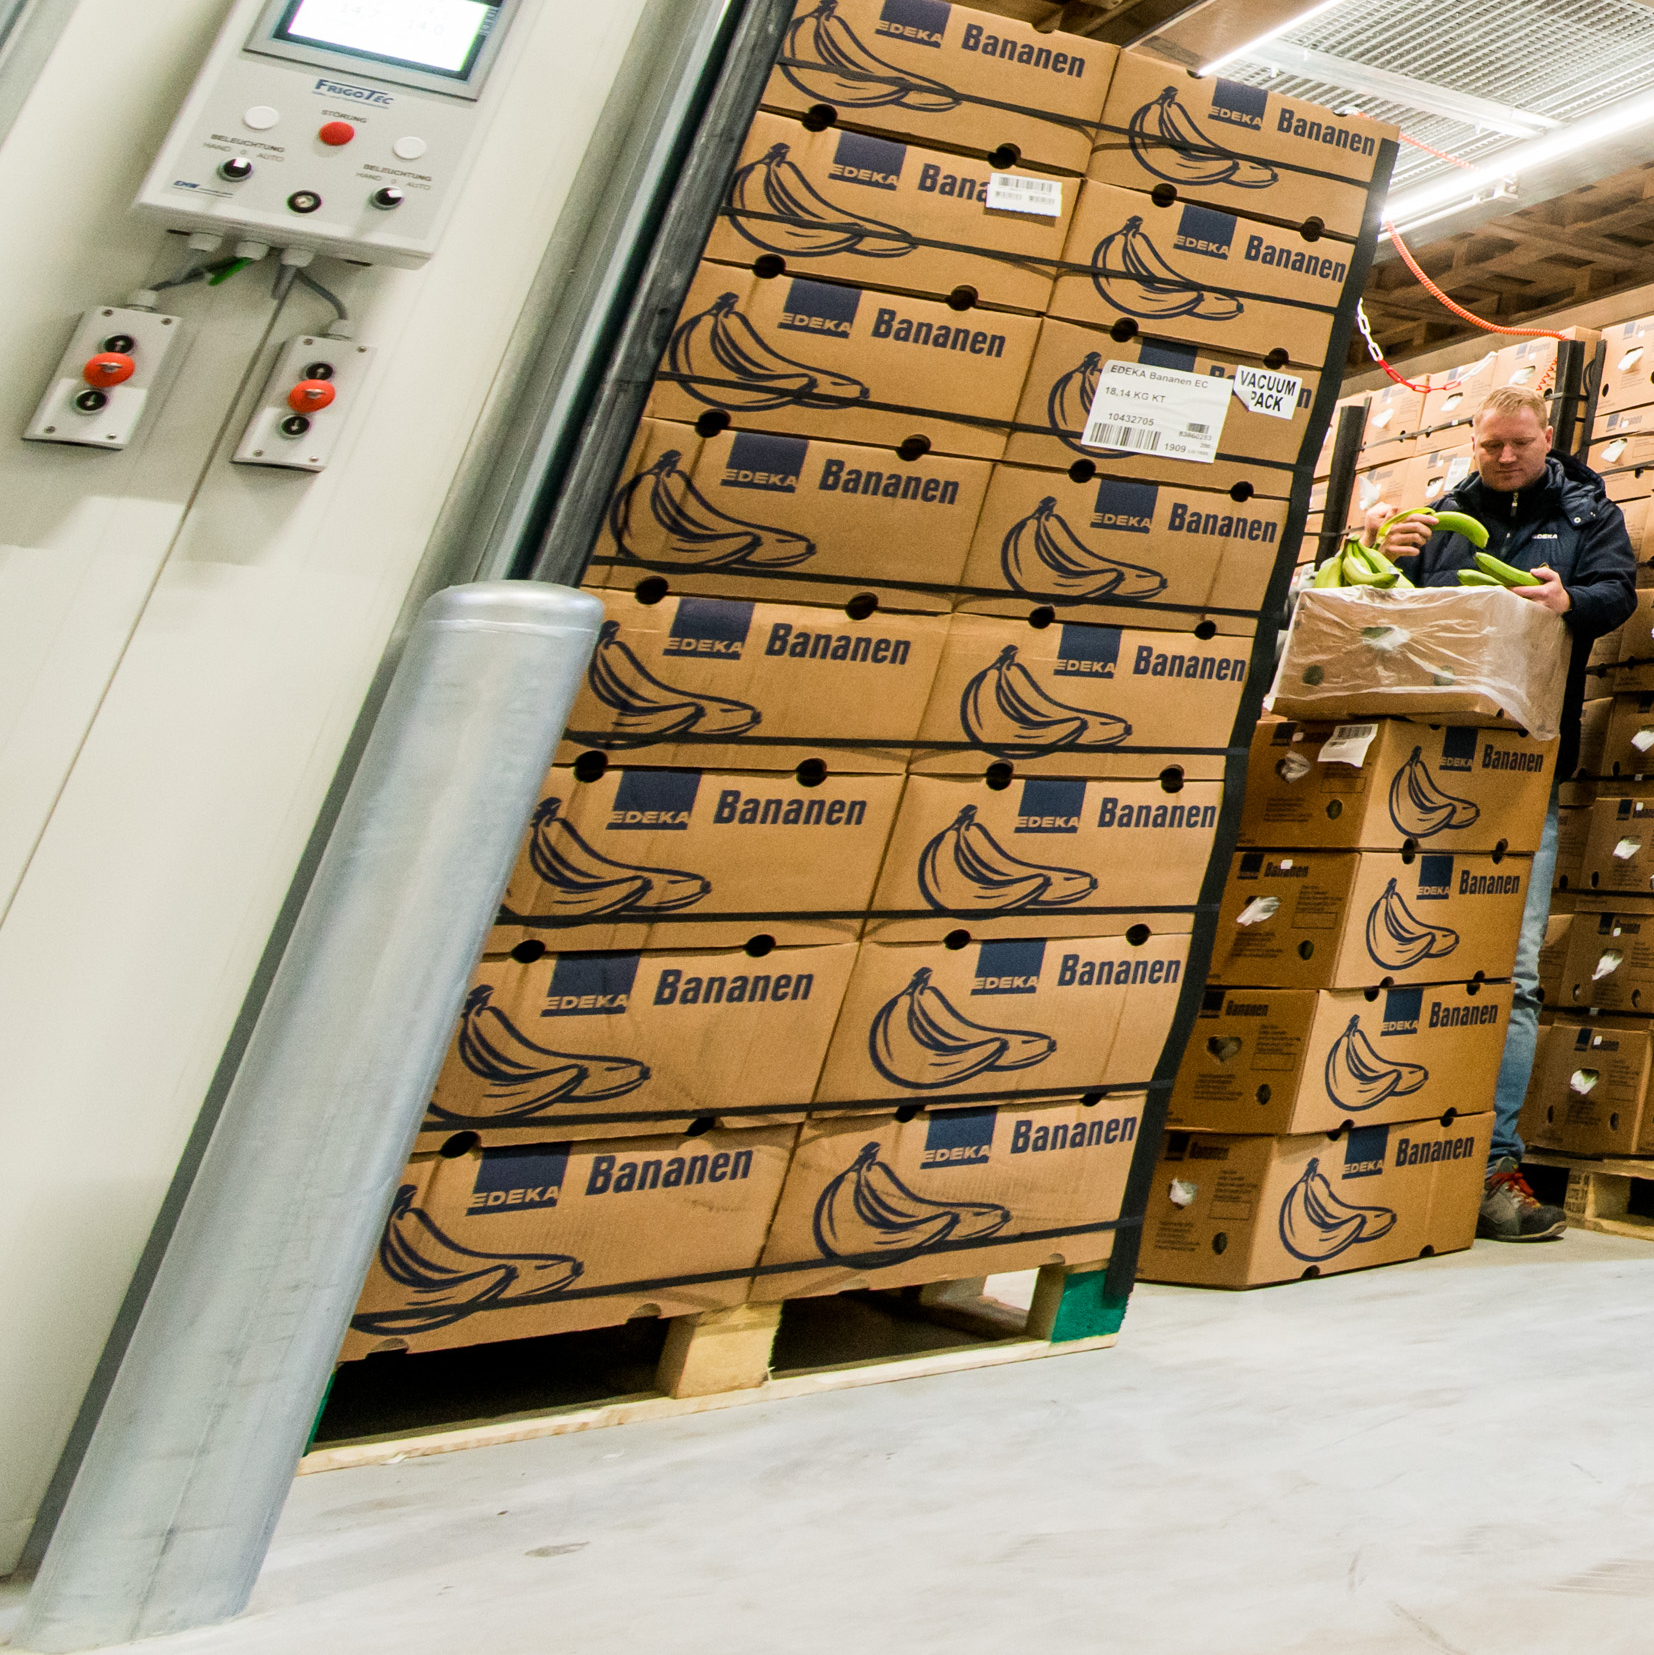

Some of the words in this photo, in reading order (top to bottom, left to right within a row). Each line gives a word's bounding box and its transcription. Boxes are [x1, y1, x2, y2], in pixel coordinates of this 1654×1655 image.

[876, 21, 943, 45] EDEKA
[961, 23, 1086, 78] Bananen
[211, 134, 285, 153] BELEUCHTUNG
[1209, 106, 1262, 127] EDEKA
[1277, 109, 1375, 156] Bananen
[256, 152, 285, 162] AUTO
[363, 164, 432, 182] BELEUCHTUNG
[355, 172, 382, 182] HAND
[406, 181, 431, 190] AUTO
[830, 164, 899, 187] EDEKA
[1174, 235, 1230, 256] EDEKA
[1244, 235, 1346, 283] Bananen
[780, 312, 853, 334] EDEKA
[872, 308, 1006, 358] Bananen
[1110, 364, 1146, 378] EDEKA
[1149, 372, 1192, 386] Bananen
[1194, 380, 1209, 389] EC
[1240, 370, 1297, 397] VACUUM
[1134, 391, 1149, 401] KG
[1151, 394, 1166, 403] KT
[1108, 412, 1155, 427] 10432705
[1164, 443, 1187, 453] 1909
[722, 468, 799, 488] EDEKA
[819, 458, 959, 505] Bananen
[1091, 512, 1152, 529] EDEKA
[1168, 503, 1278, 544] Bananen
[665, 637, 742, 655] EDEKA
[765, 622, 911, 665] Bananen
[1055, 659, 1116, 674] EDEKA
[1133, 645, 1246, 683] Bananen
[1440, 756, 1473, 767] EDEKA
[1482, 744, 1543, 773] Bananen
[609, 810, 689, 825] EDEKA
[713, 789, 867, 826] Bananen
[1016, 816, 1080, 828] EDEKA
[1098, 797, 1217, 828] Bananen
[1417, 885, 1450, 897] EDEKA
[1459, 870, 1520, 896] Bananen
[973, 975, 1040, 990] EDEKA
[1057, 954, 1181, 988] Bananen
[543, 992, 630, 1012] EDEKA
[654, 969, 814, 1006] Bananen
[1382, 1020, 1419, 1032] EDEKA
[1429, 1001, 1498, 1028] Bananen
[922, 1143, 992, 1163] EDEKA
[1011, 1116, 1138, 1155] Bananen
[1344, 1159, 1384, 1174] EDEKA
[1395, 1136, 1474, 1167] Bananen
[470, 1184, 561, 1208] EDEKA
[585, 1149, 753, 1196] Bananen
